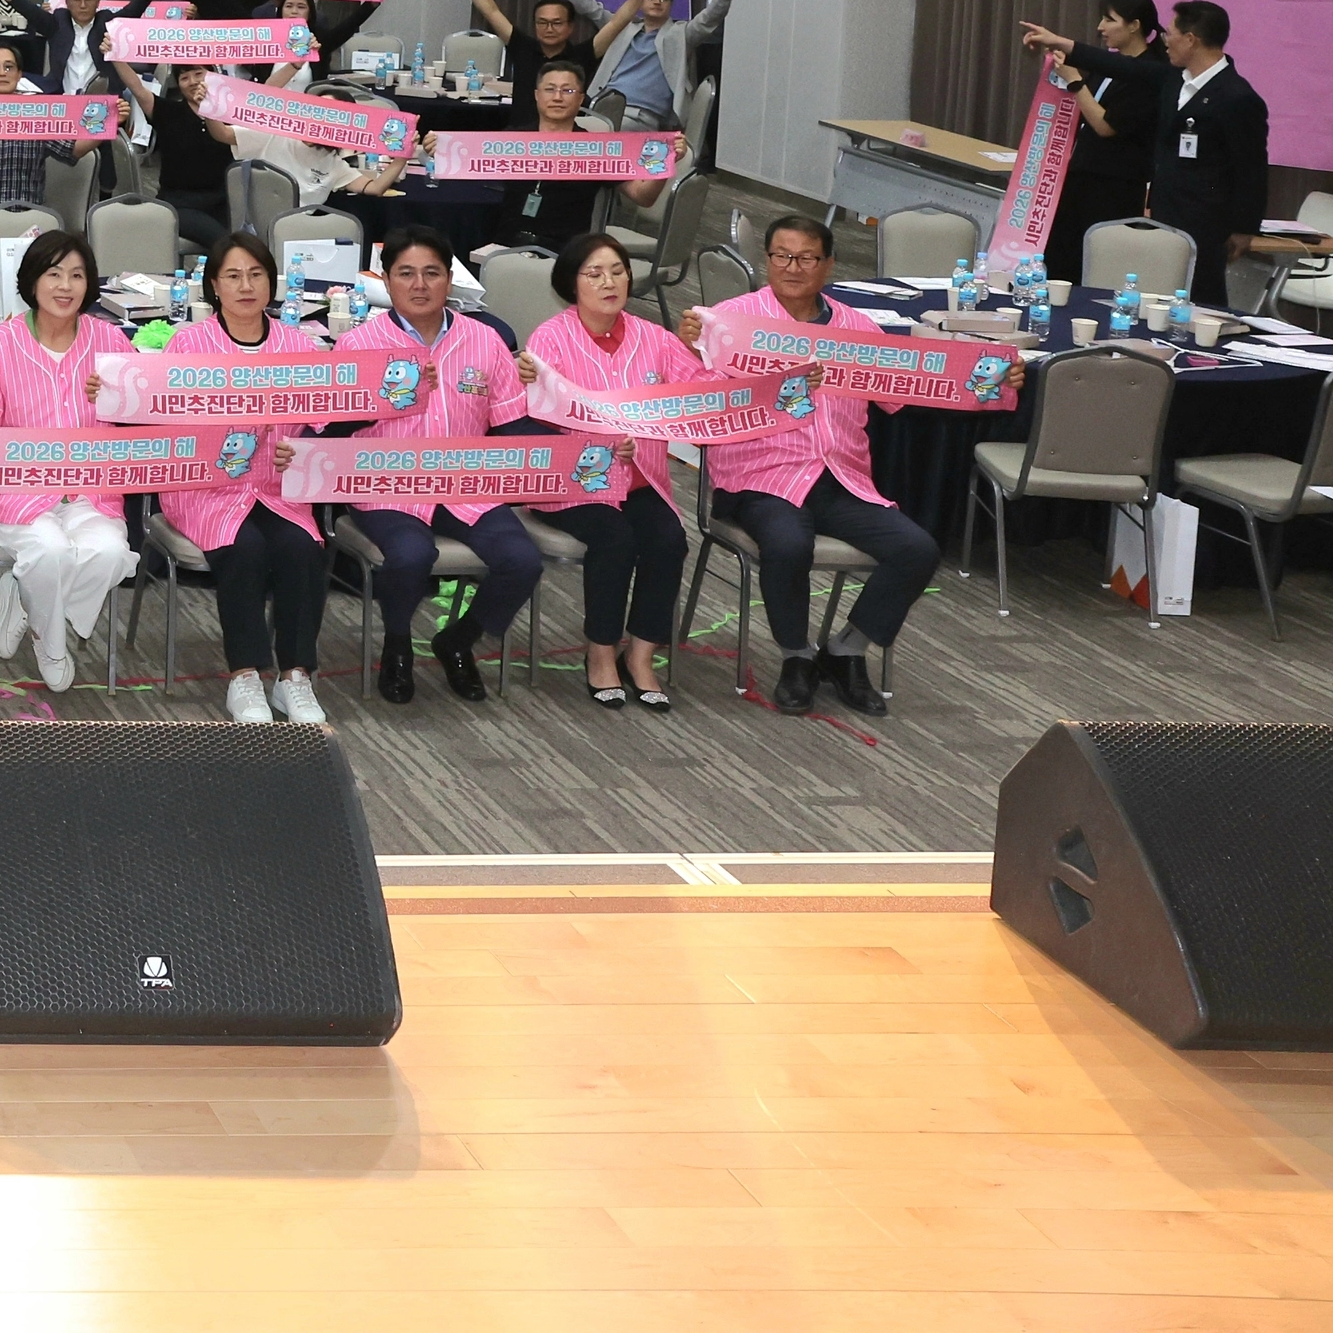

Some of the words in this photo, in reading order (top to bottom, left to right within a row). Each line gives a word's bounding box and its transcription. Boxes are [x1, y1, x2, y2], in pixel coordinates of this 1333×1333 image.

[482, 142, 524, 157] 2026
[528, 142, 602, 157] 양산방문의
[605, 142, 621, 157] 해
[469, 158, 554, 174] 시민추진단과
[558, 158, 636, 174] 함께합니다.
[1009, 191, 1032, 228] 2026
[1021, 121, 1051, 188] 양산방문의
[1040, 103, 1057, 119] 해
[1025, 169, 1058, 247] 시민추진단과
[751, 330, 812, 356] 2026
[816, 339, 919, 371] 양산방문의
[921, 352, 946, 372] 해
[168, 366, 226, 389] 2026
[231, 365, 331, 389] 양산방문의
[336, 365, 356, 387] 해
[850, 371, 960, 402] 함께합니다.
[150, 390, 267, 415] 시민추진단과
[273, 389, 376, 413] 함께합니다.
[621, 391, 725, 419] 양산방문의
[729, 387, 751, 406] 해
[667, 407, 775, 437] 함께합니다.
[5, 442, 62, 463] 2026
[66, 438, 168, 461] 양산방문의
[171, 437, 194, 459] 해
[354, 450, 413, 472] 2026
[417, 449, 523, 471] 양산방문의
[526, 448, 550, 470] 해
[105, 459, 213, 483] 함께합니다.
[333, 473, 452, 494] 시민추진단과
[457, 472, 569, 494] 함께합니다.
[140, 978, 173, 987] TPA
